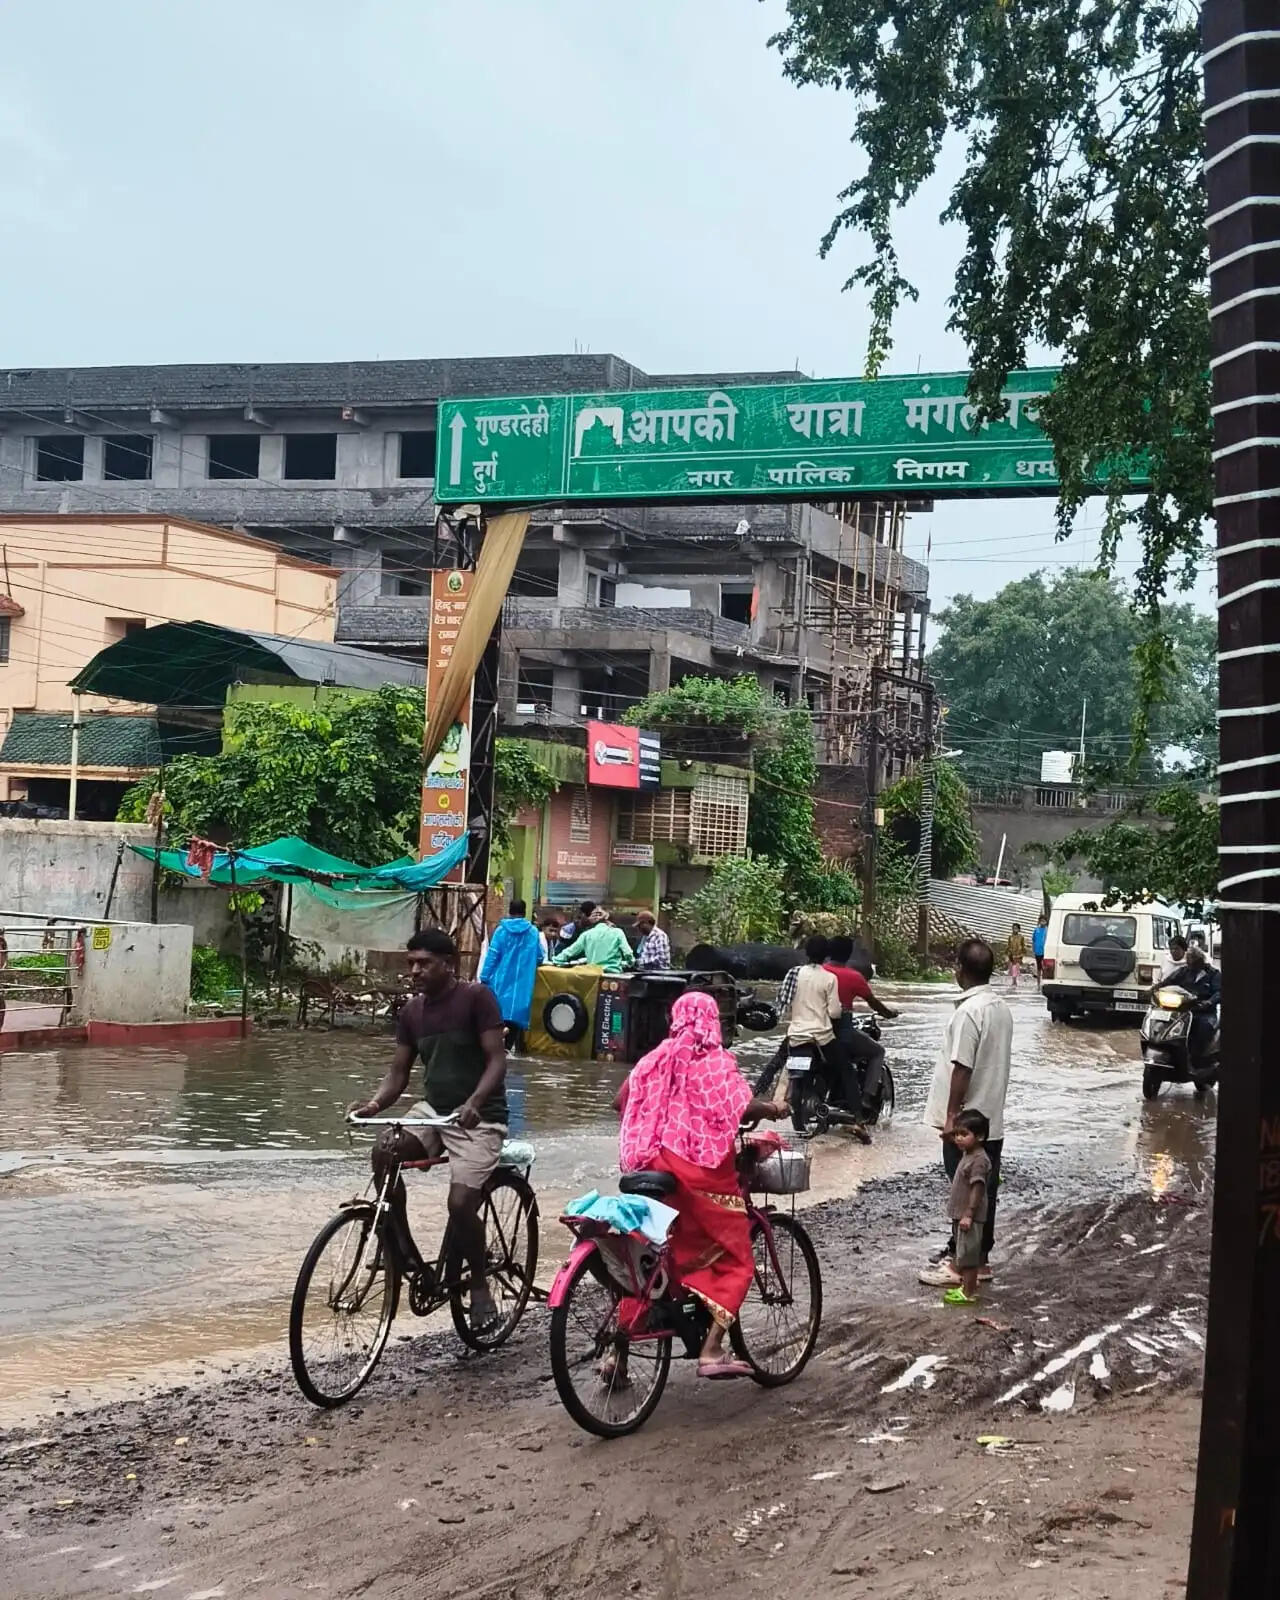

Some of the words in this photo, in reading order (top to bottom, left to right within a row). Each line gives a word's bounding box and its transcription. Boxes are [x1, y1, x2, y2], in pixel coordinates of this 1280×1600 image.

[628, 390, 739, 444] आपकी
[786, 400, 867, 439] यात्रा
[472, 451, 499, 494] दुर्ग
[686, 470, 736, 488] नगर
[892, 458, 970, 481] निगम
